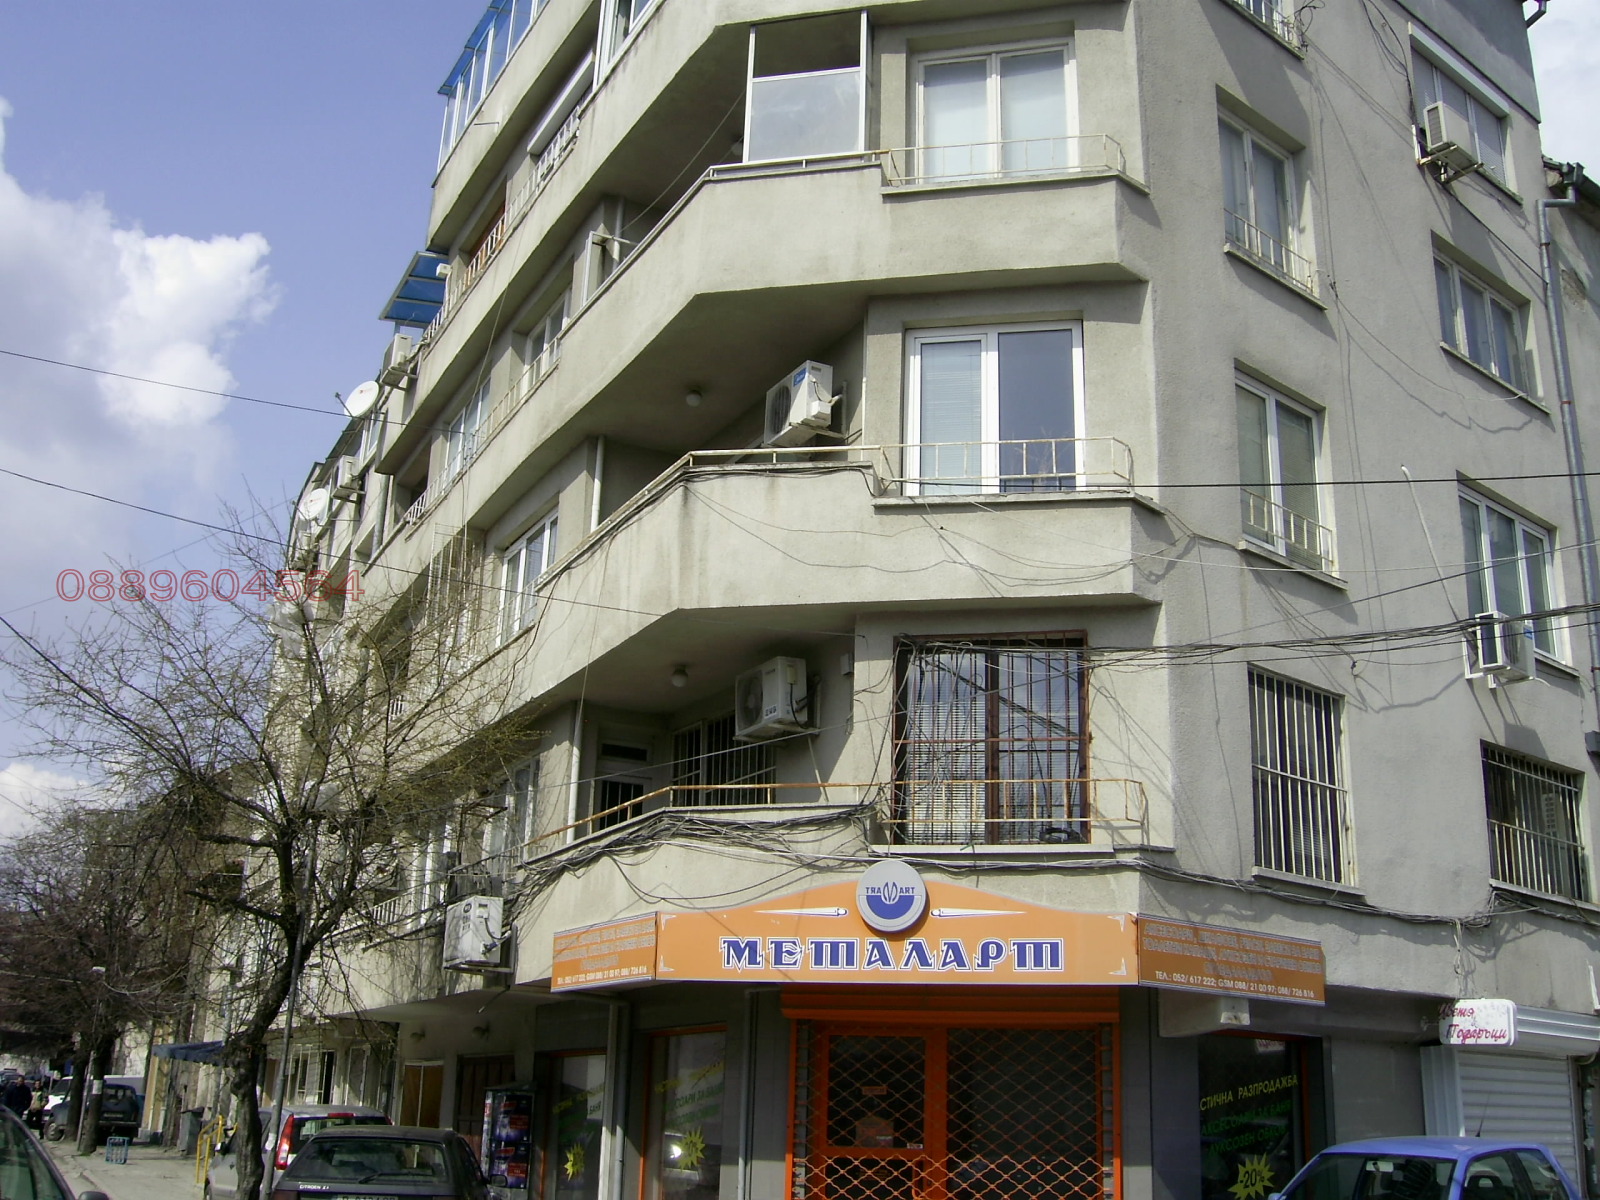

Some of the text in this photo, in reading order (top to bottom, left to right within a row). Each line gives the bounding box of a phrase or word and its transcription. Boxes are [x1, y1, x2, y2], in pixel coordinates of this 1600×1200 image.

[720, 936, 1064, 973] МЕТАЛАРТ
[1172, 973, 1188, 984] 052/
[1189, 975, 1201, 985] 617
[1218, 979, 1233, 988] GSM
[1250, 982, 1257, 991] 21
[1292, 988, 1302, 997] 726
[1446, 1024, 1507, 1044] Подаръци
[1238, 1074, 1299, 1100] РАЗПРОДАЖБА
[1239, 1168, 1265, 1189] -20%
